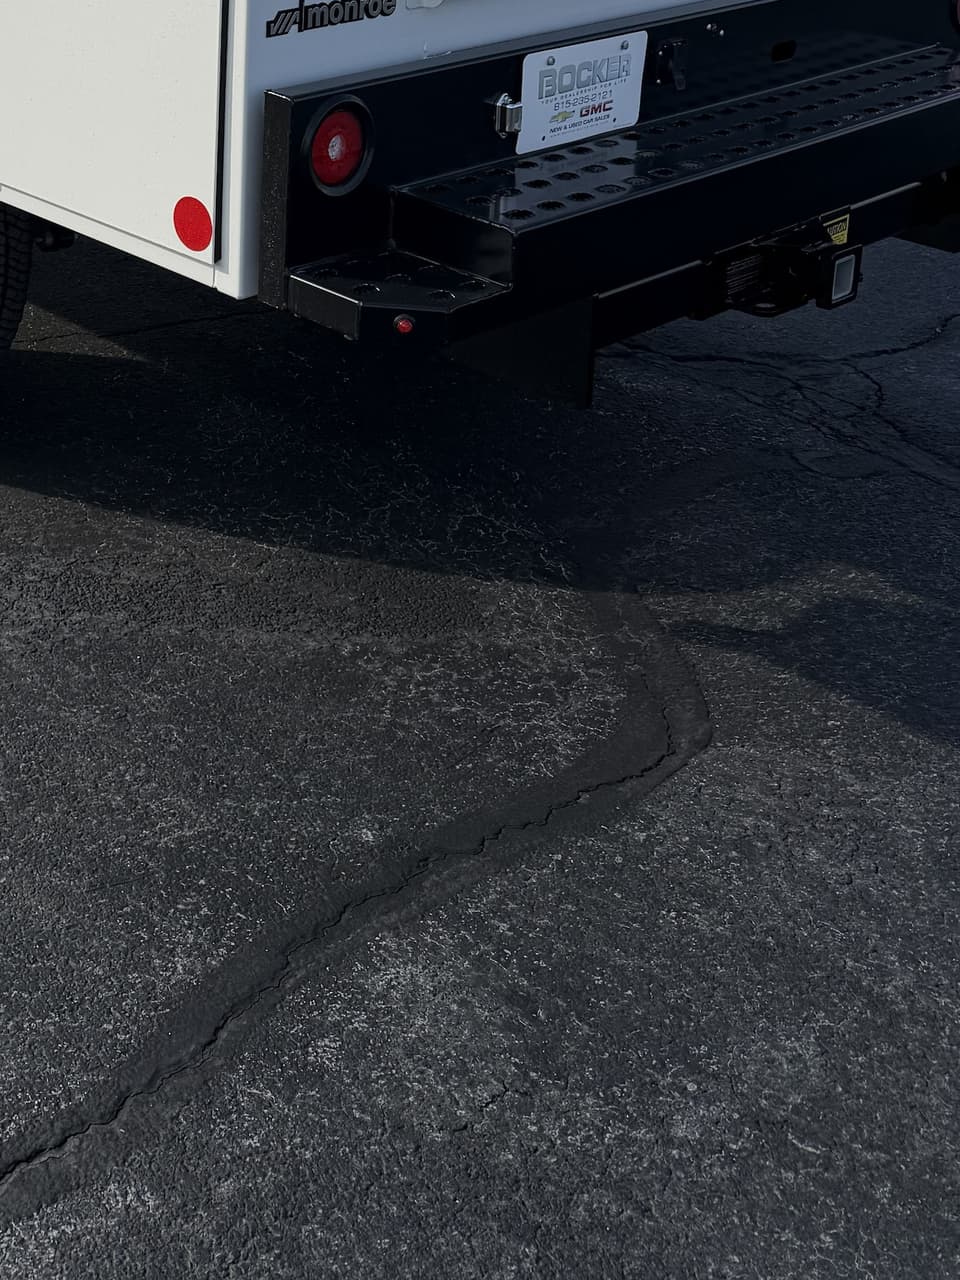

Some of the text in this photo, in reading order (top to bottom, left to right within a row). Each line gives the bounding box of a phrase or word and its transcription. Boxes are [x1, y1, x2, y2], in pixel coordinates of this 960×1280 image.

[538, 54, 631, 100] BOCKER
[579, 100, 614, 118] GMC
[549, 126, 563, 134] NEW
[568, 121, 582, 129] USED
[594, 114, 610, 122] SALES
